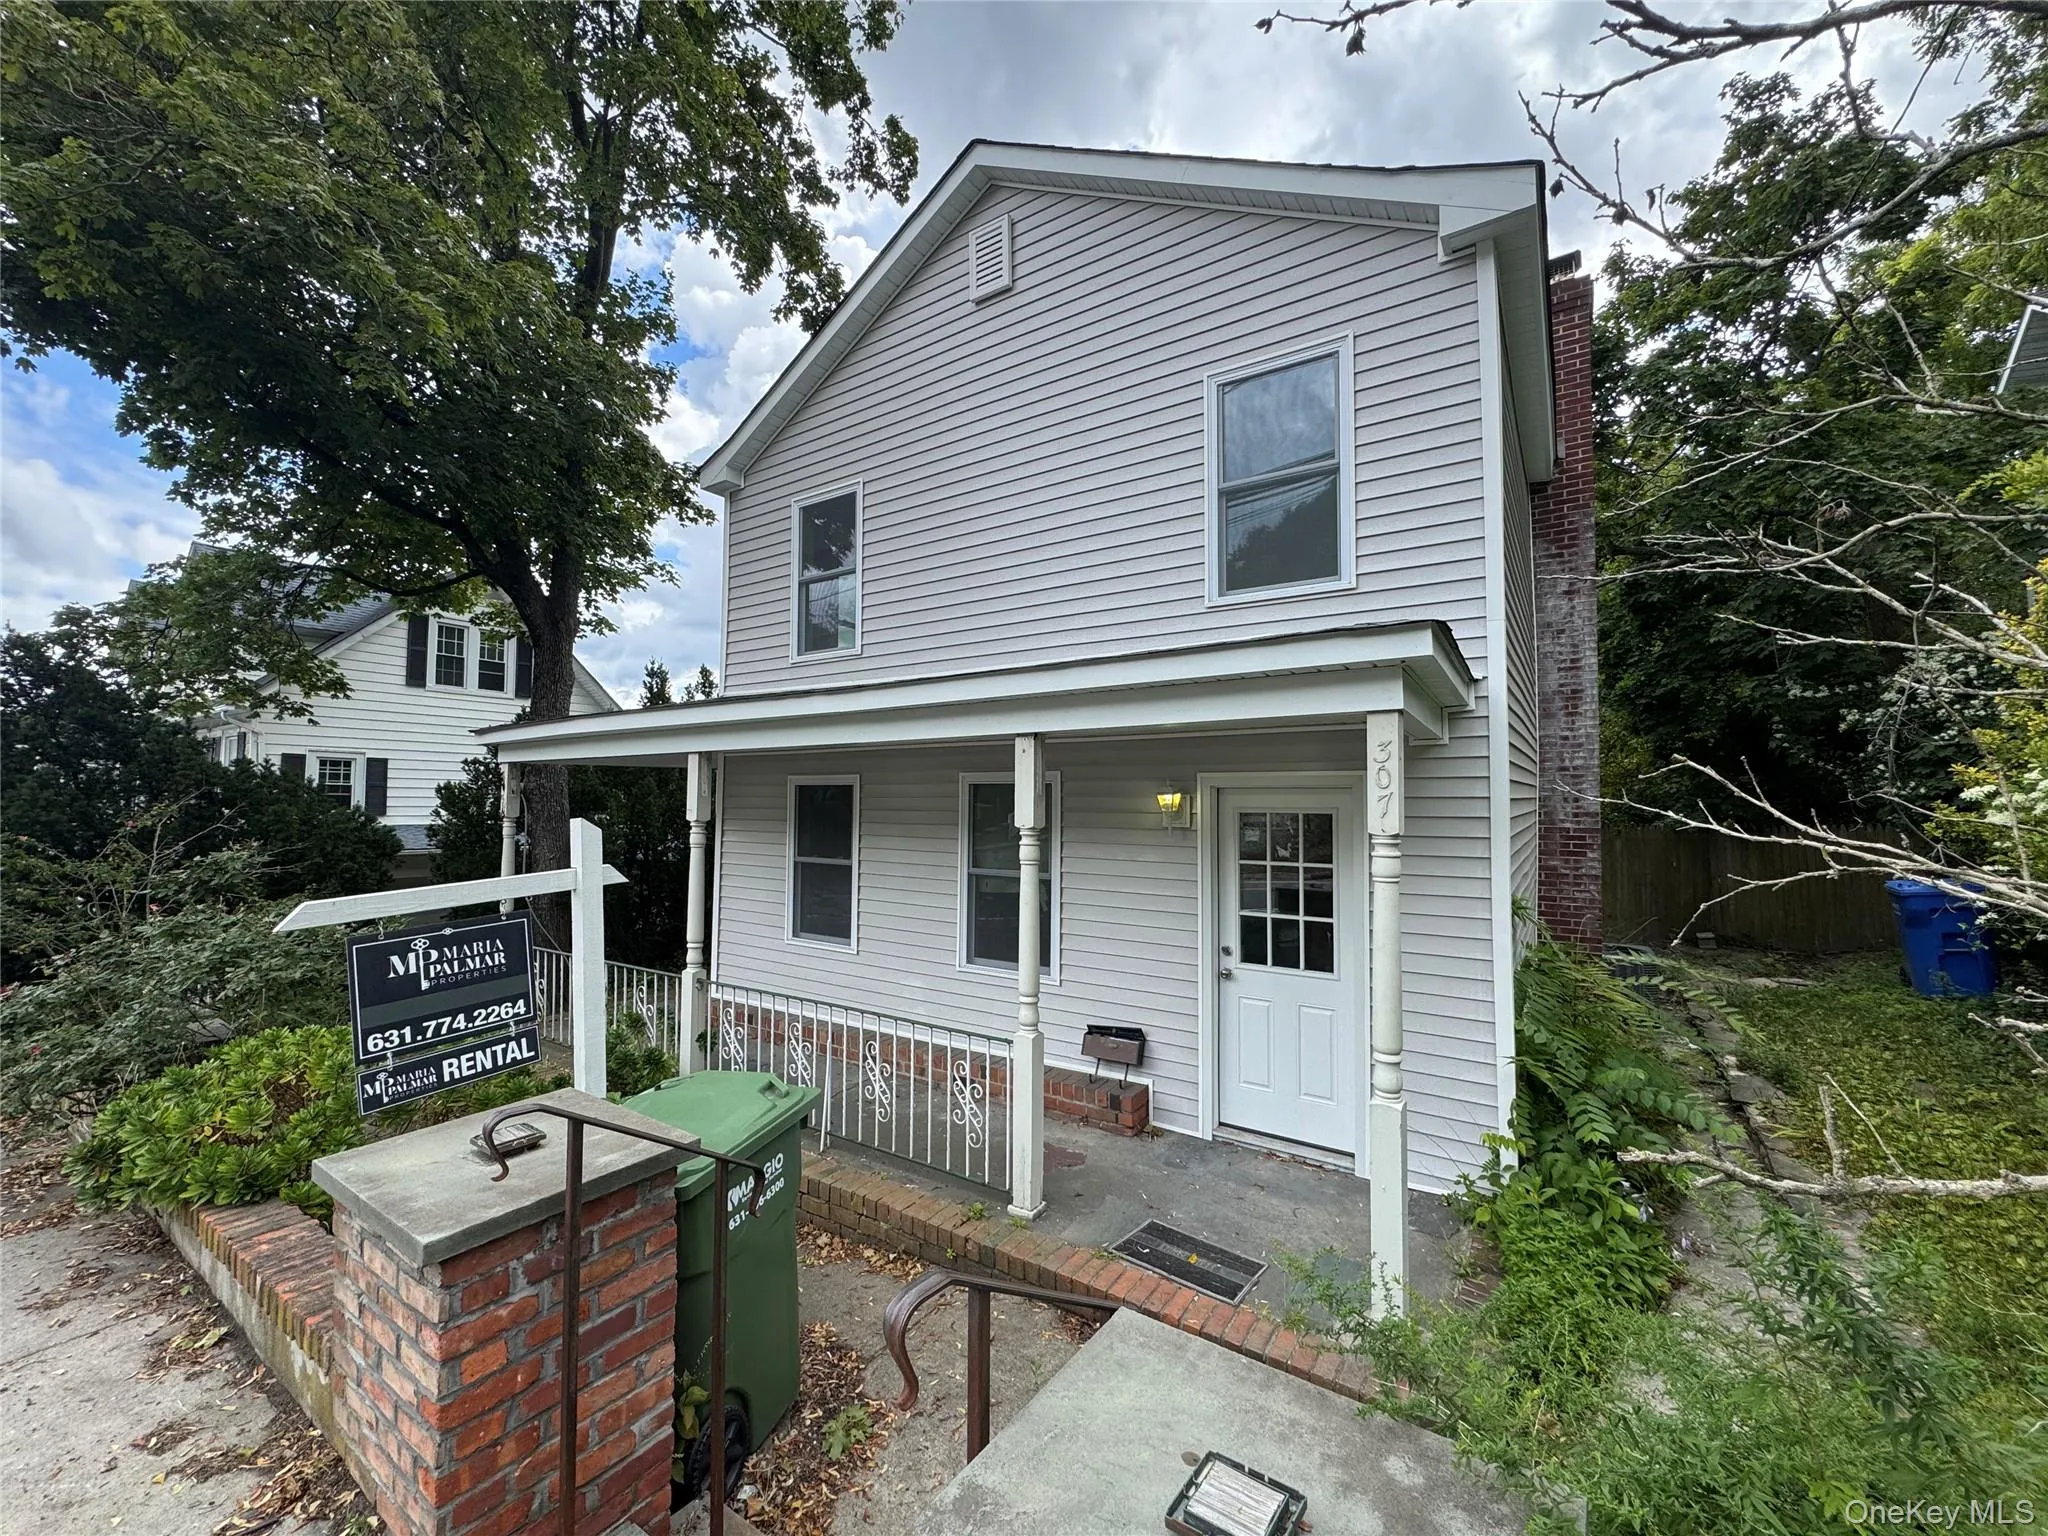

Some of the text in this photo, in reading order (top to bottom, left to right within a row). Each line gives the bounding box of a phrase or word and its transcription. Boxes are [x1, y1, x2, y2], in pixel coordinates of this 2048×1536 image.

[1373, 740, 1394, 819] 307
[429, 951, 506, 978] PALMAR
[442, 938, 504, 961] MARIA
[431, 965, 507, 986] PROPERTIES
[367, 999, 527, 1052] 631.774.2264
[397, 1066, 436, 1084] MARIA
[442, 1037, 535, 1082] RENTAL
[388, 1074, 437, 1095] PALMAR
[737, 1152, 784, 1198] MAGIO
[728, 1177, 785, 1231] 631-6-6300
